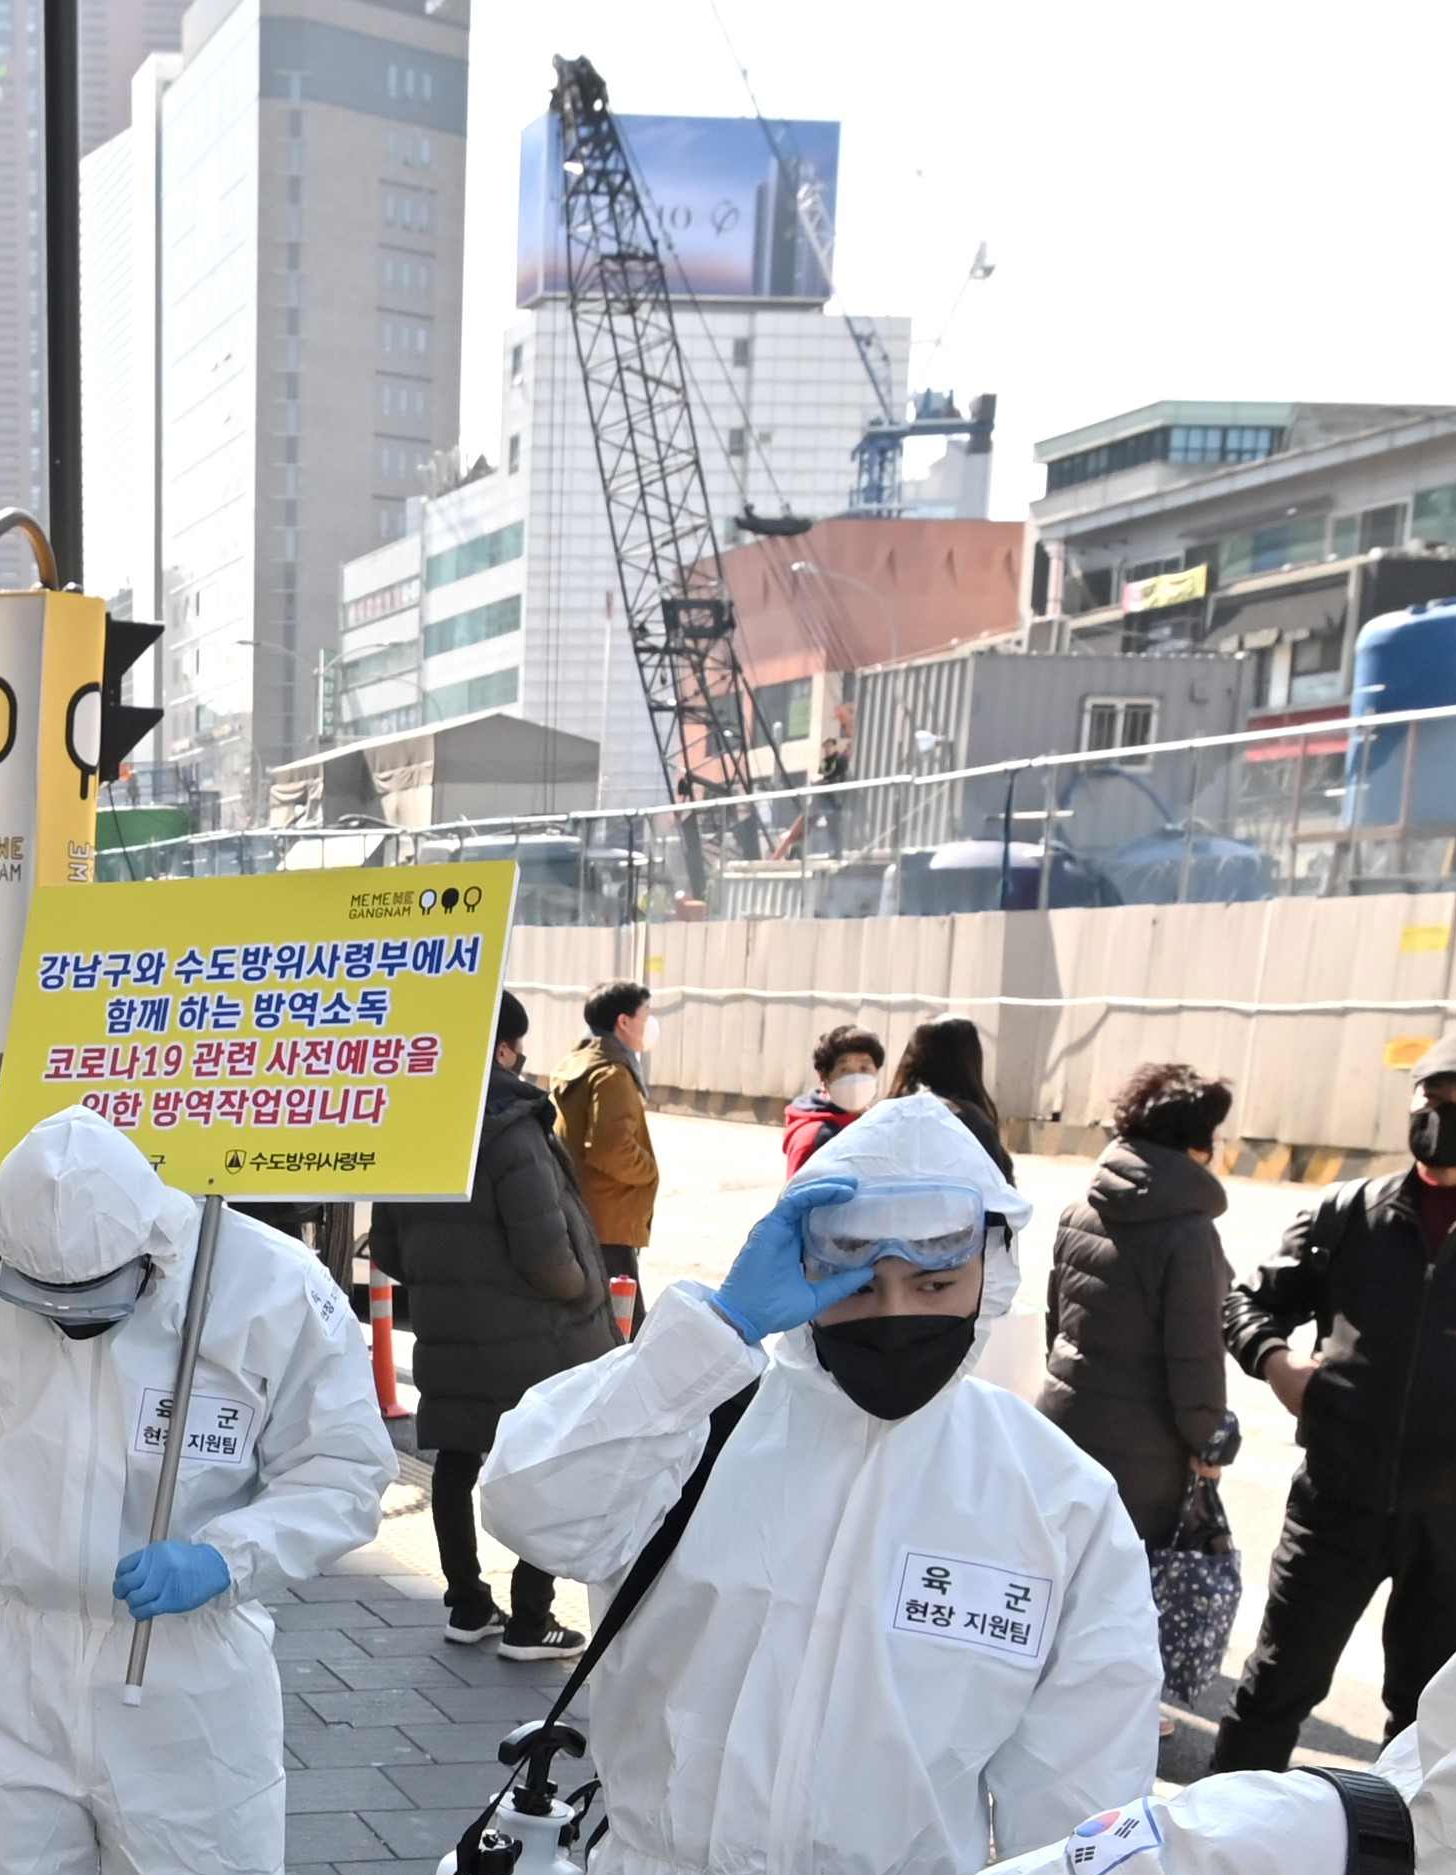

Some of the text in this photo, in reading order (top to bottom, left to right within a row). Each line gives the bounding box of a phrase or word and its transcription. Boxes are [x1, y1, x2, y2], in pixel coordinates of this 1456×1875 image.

[348, 906, 411, 920] GANGNAM
[38, 935, 483, 990] 강남구와 수도방위사령부에서
[106, 988, 389, 1035] 함께 하는 방역소독
[43, 1036, 441, 1082] 코로나19 관련 사전예방을
[151, 1086, 387, 1128] 방역작업입니다
[248, 1151, 377, 1175] 수도방위사령부
[216, 1407, 239, 1431] 군
[187, 1432, 237, 1455] 지원팀
[921, 1566, 1032, 1613] 육 군
[905, 1599, 1032, 1646] 현장 지원팀
